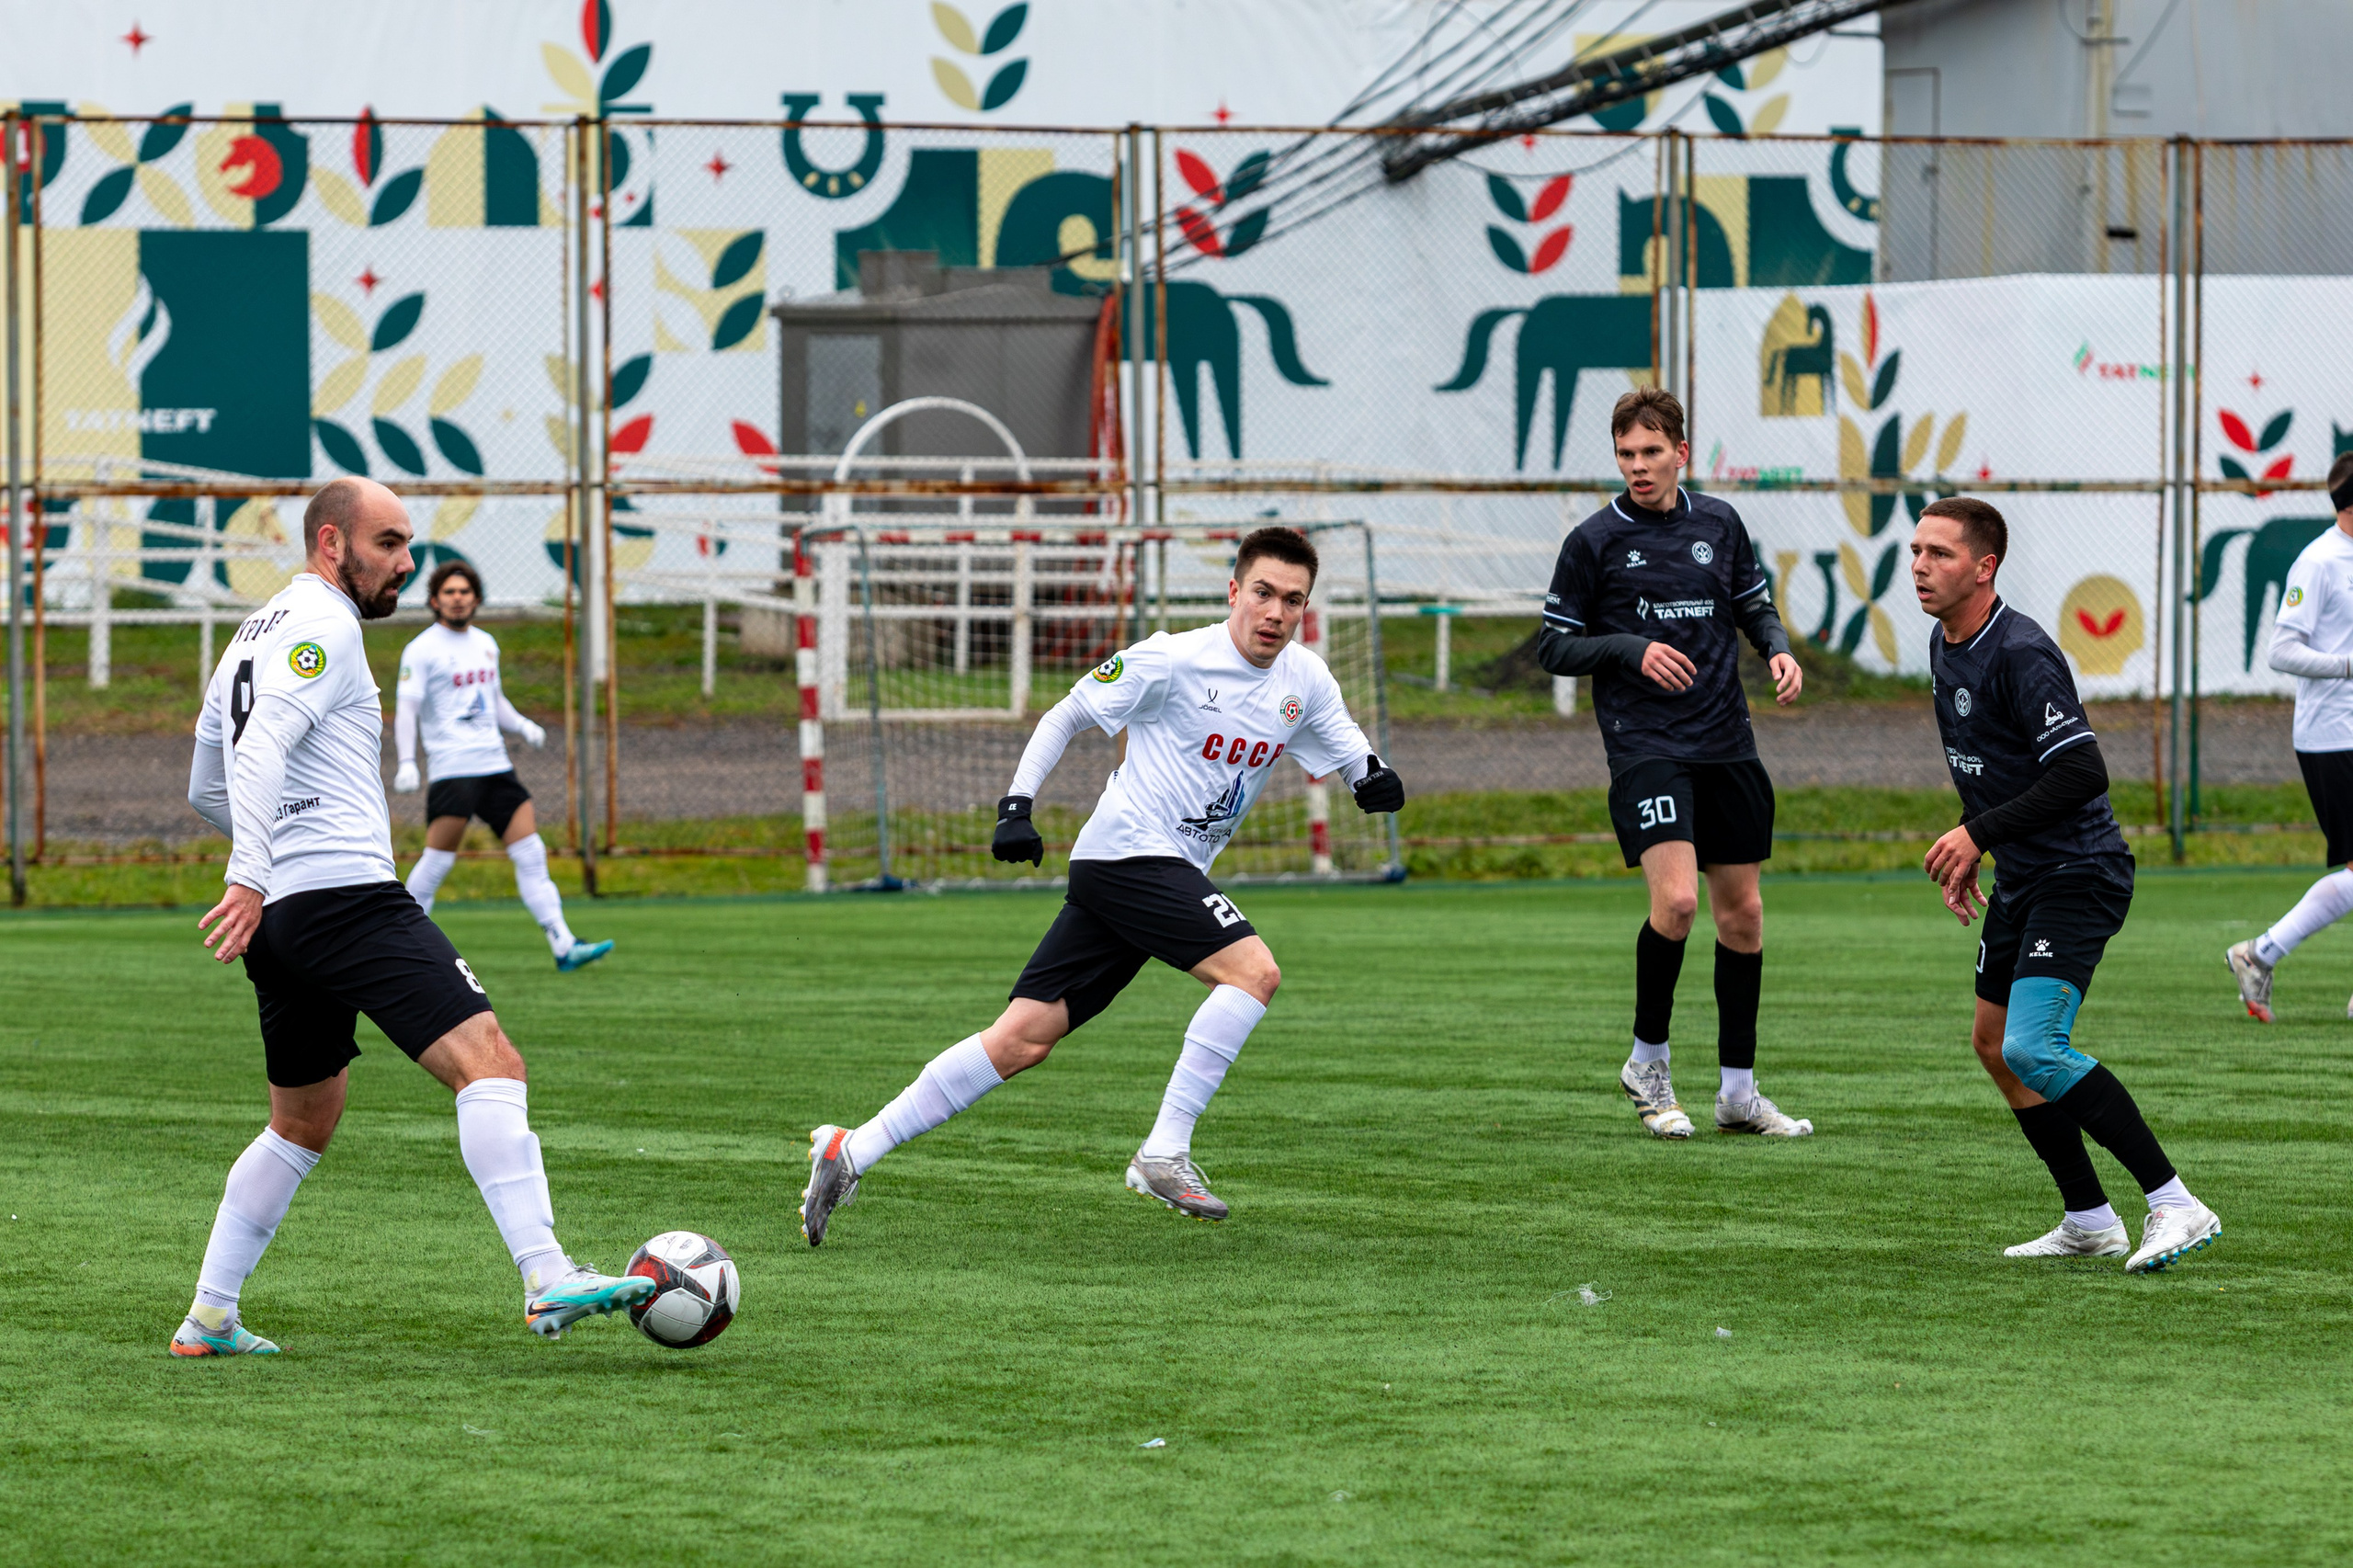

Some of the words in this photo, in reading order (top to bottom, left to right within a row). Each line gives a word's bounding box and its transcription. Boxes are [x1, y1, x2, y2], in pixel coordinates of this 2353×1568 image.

[64, 407, 218, 434] TATNEFT
[1626, 560, 1647, 568] KELME
[1654, 606, 1714, 619] TATNEFT
[1199, 704, 1222, 713] JÖGEL
[1201, 733, 1285, 767] СССР
[283, 797, 320, 816] Гарант
[1638, 795, 1677, 830] 30
[455, 958, 485, 994] 8
